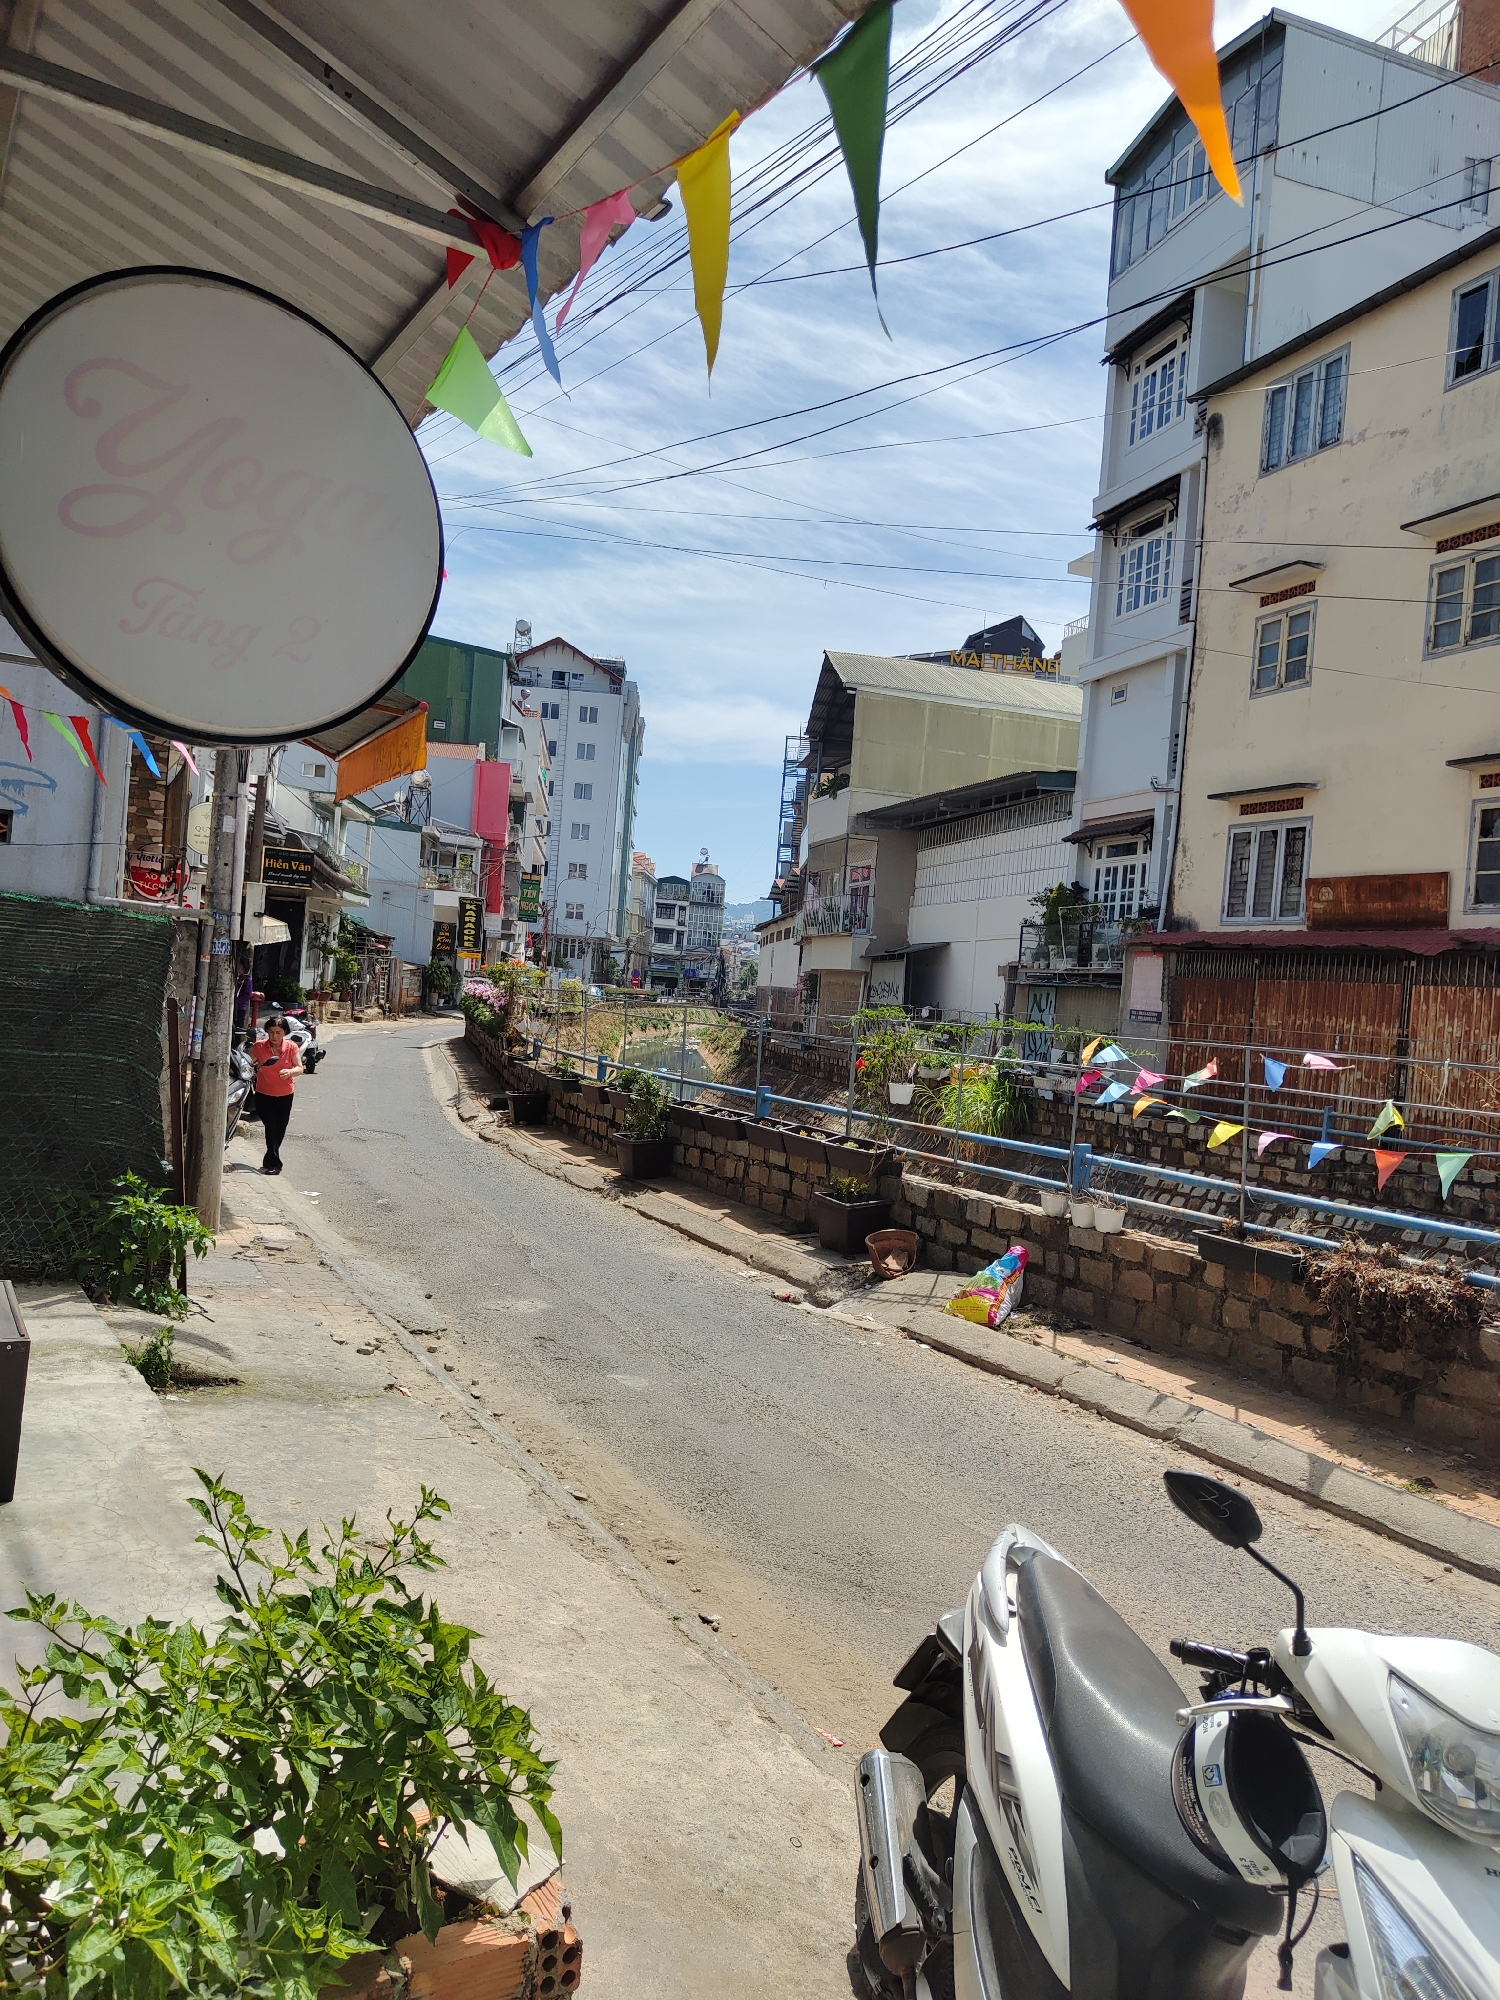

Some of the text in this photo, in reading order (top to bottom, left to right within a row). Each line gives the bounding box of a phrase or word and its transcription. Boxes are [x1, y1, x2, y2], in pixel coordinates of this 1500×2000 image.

[58, 357, 402, 564] Yoga
[272, 616, 321, 663] 2
[950, 649, 985, 668] MAI
[463, 903, 477, 948] KARAOKE
[1009, 1846, 1043, 1914] PGM-FI
